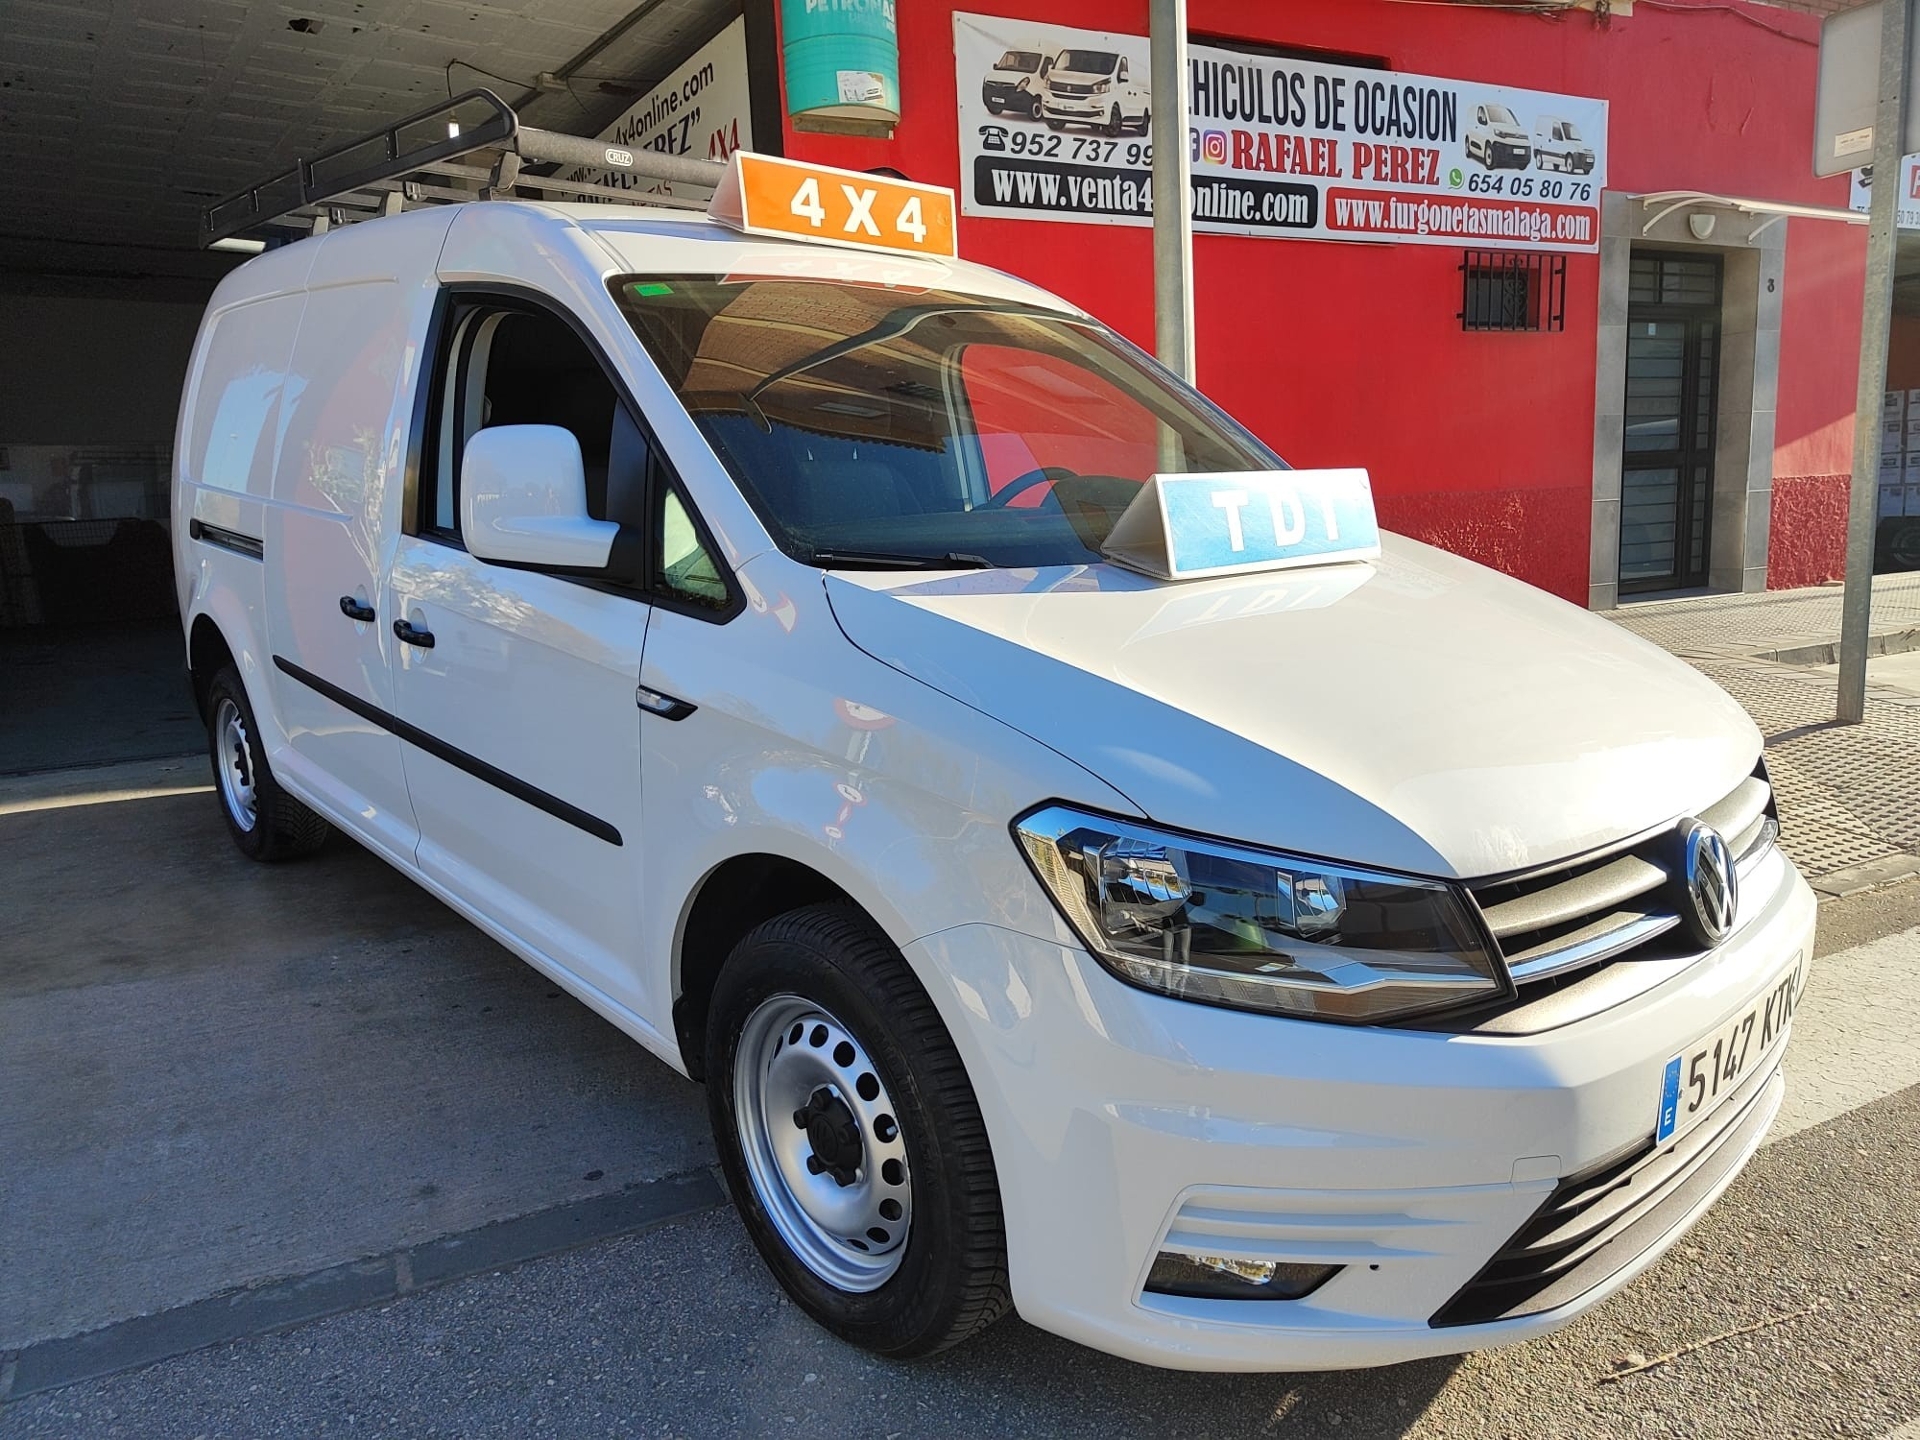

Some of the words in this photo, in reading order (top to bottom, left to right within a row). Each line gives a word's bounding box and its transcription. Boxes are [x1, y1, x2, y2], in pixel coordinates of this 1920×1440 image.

[1187, 58, 1306, 128] HICULOS
[1314, 75, 1346, 131] DE
[1354, 80, 1457, 142] OCASION
[607, 151, 631, 164] CRUZ
[1010, 131, 1062, 158] 952
[1071, 138, 1118, 163] 737
[1126, 144, 1153, 167] 99
[1231, 129, 1342, 178] RAFAEL
[1352, 142, 1440, 186] PEREZ
[1468, 173, 1503, 194] 654
[1510, 177, 1533, 197] 05
[1539, 179, 1562, 199] 80
[1569, 182, 1591, 201] 76
[1334, 196, 1591, 241] www.furgonetasmalaga.com
[1767, 278, 1775, 293] 3
[1688, 1010, 1757, 1113] 5147
[1664, 1107, 1672, 1126] E
